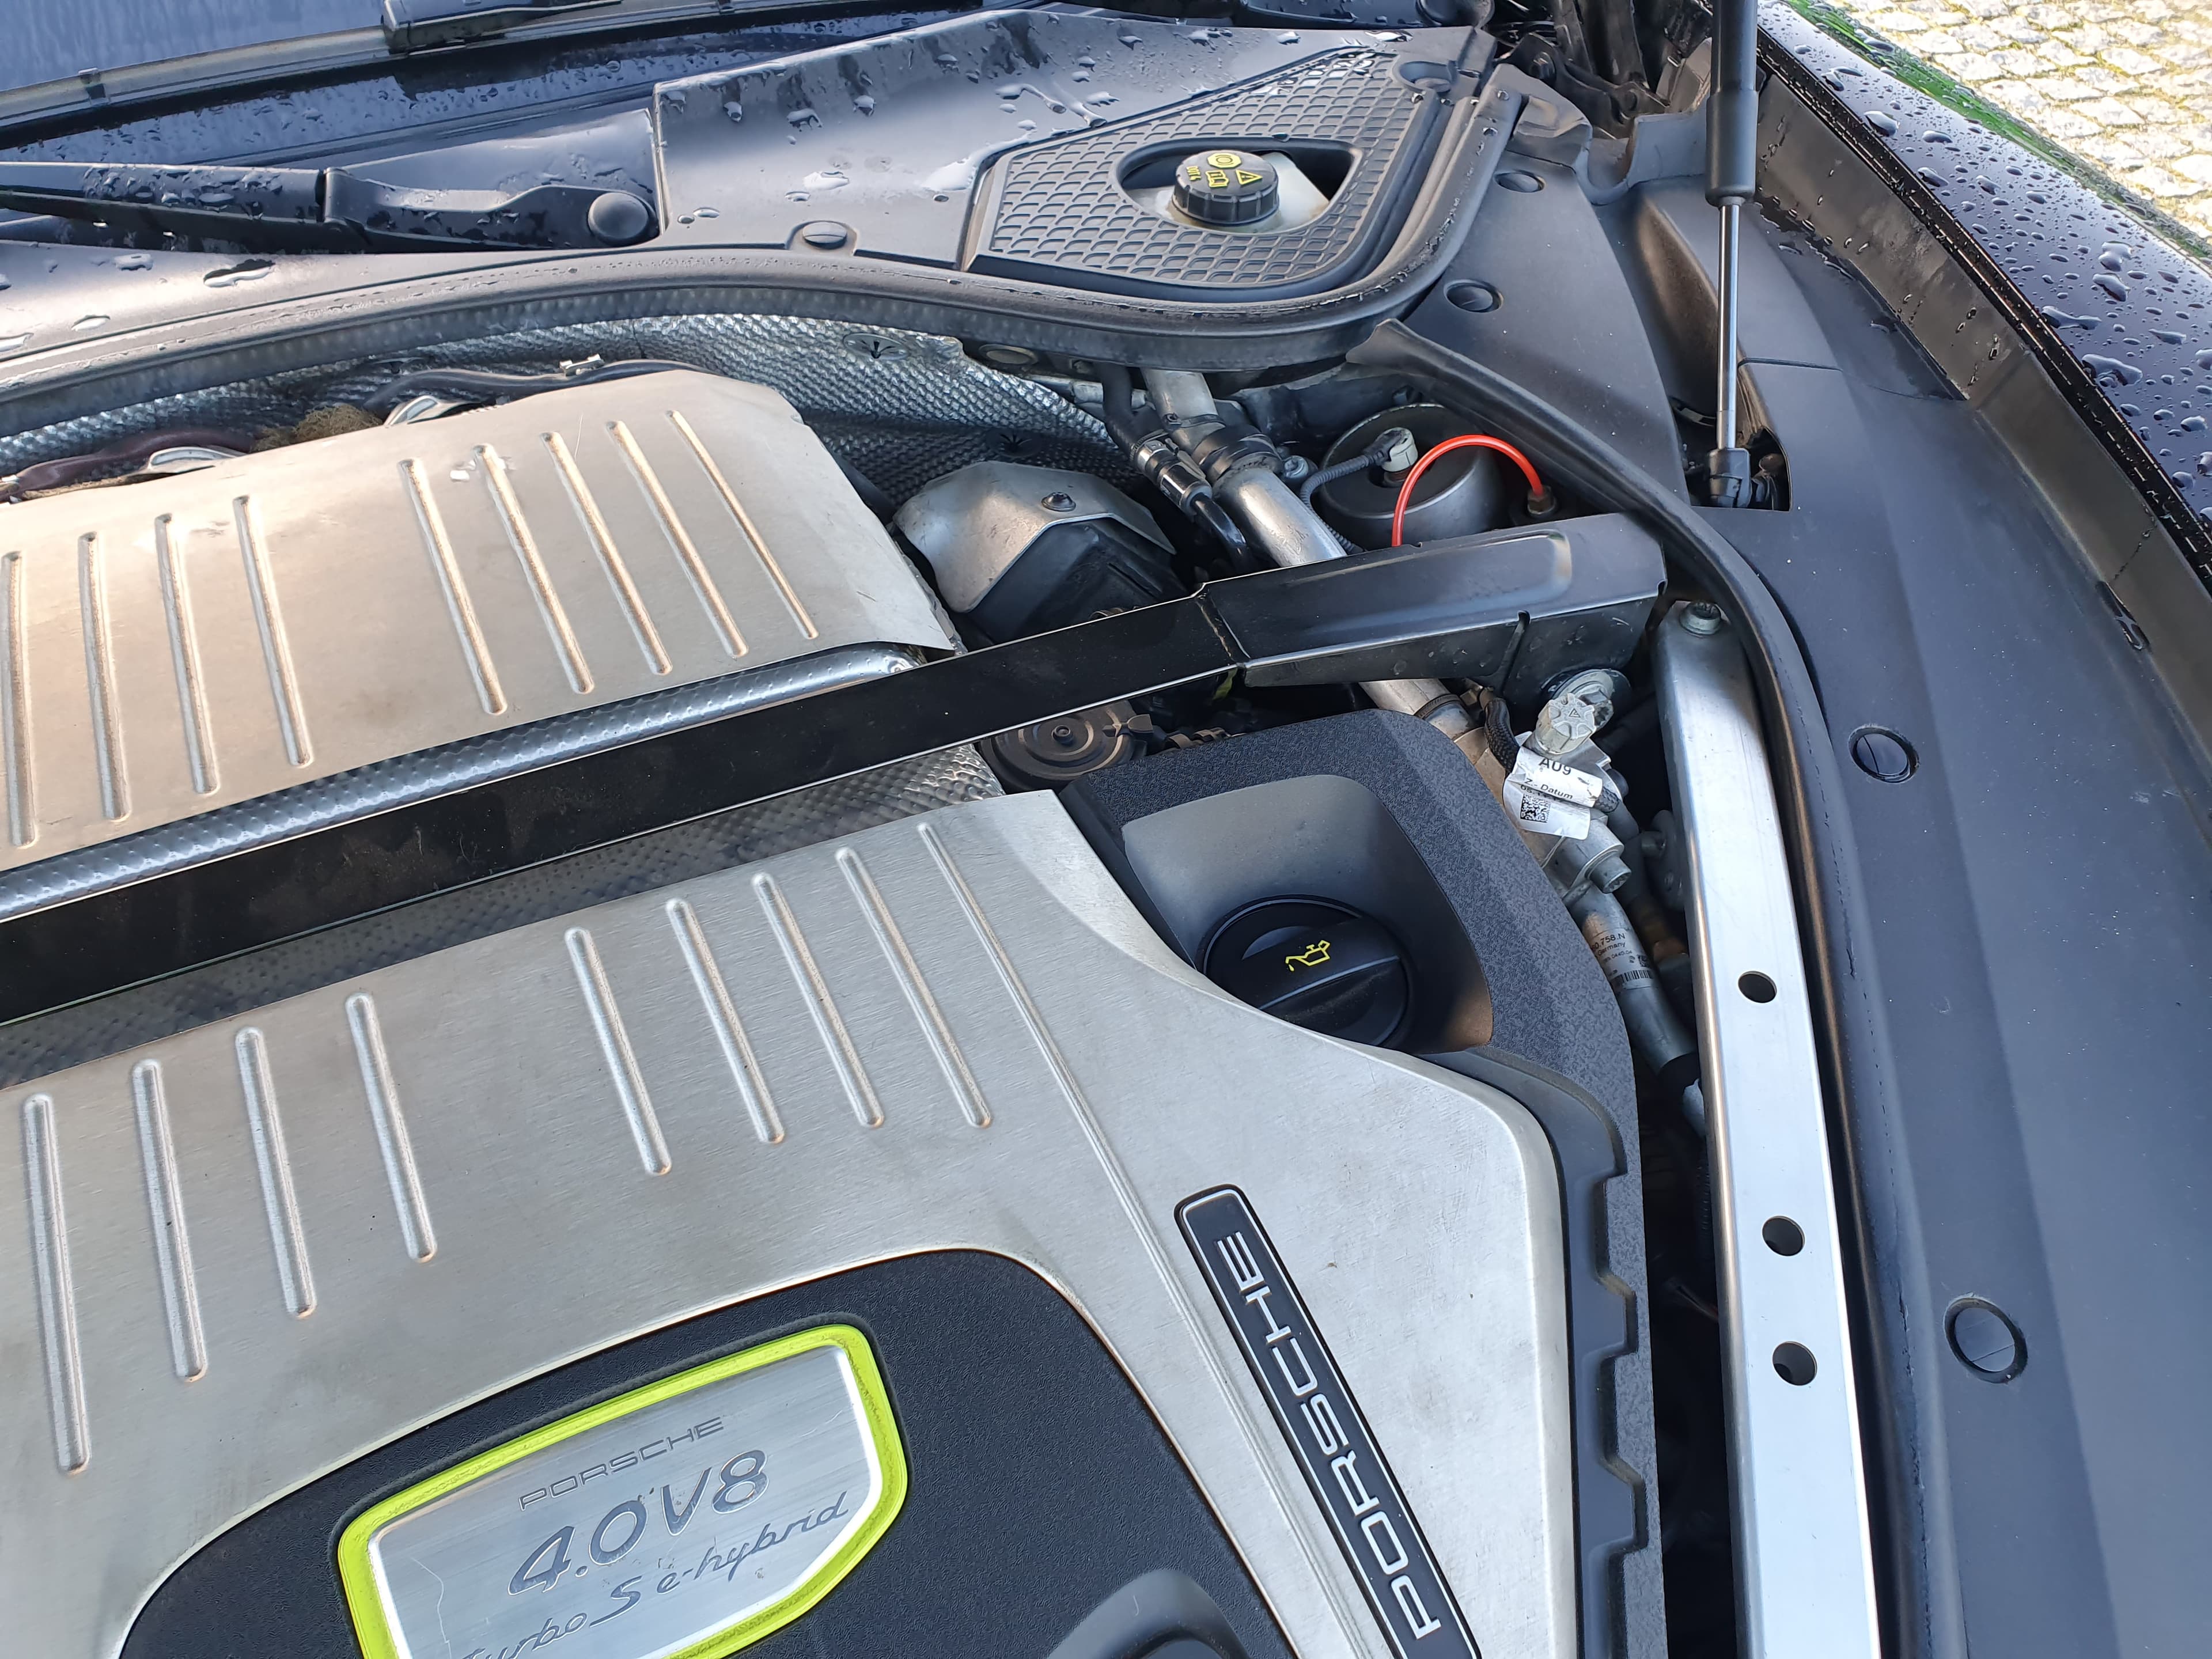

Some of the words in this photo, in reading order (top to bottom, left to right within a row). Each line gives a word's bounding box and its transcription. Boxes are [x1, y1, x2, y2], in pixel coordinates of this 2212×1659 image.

[1540, 784, 1573, 800] Datum
[1597, 941, 1626, 956] Germany
[520, 1416, 724, 1510] PORSCHE
[1216, 1230, 1441, 1641] PORSCHE
[656, 1491, 848, 1595] e-hybrid
